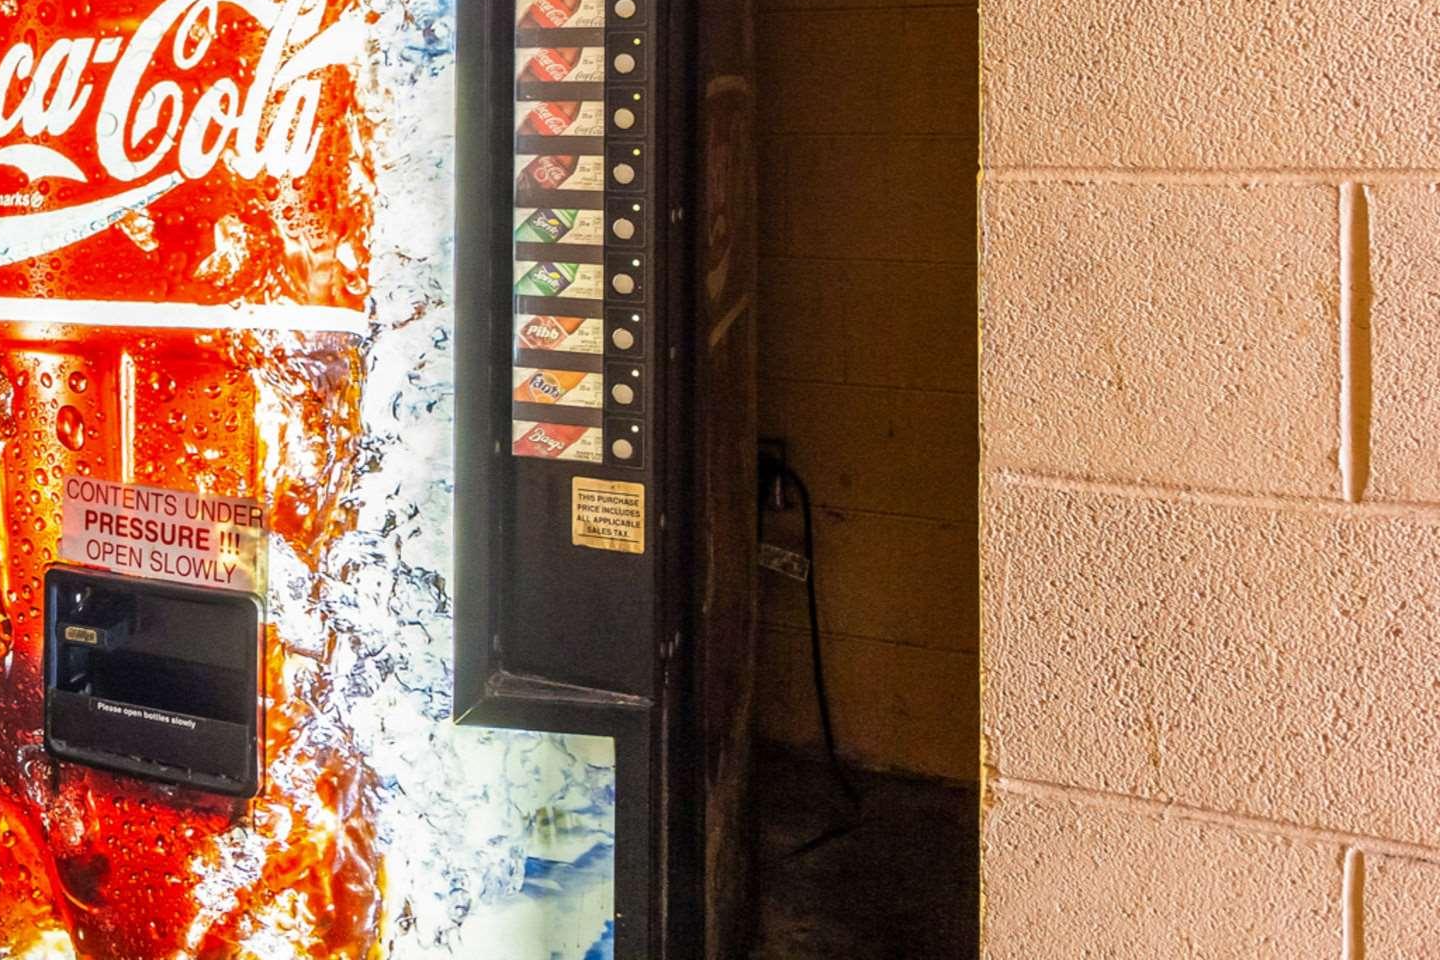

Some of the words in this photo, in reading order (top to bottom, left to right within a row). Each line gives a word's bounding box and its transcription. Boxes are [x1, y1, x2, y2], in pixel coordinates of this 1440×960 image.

[66, 478, 177, 516] CONTENTS
[185, 497, 264, 529] UNDER
[577, 503, 600, 513] PRICE
[601, 506, 641, 518] INCLUDES
[578, 493, 595, 502] THIS
[597, 495, 640, 508] PURCHASE
[577, 514, 592, 523] ALL
[593, 516, 641, 528] APPLICABLE
[587, 526, 612, 536] SALES
[613, 529, 628, 538] TAX
[85, 510, 211, 552] PRESSURE
[219, 531, 241, 555] !!!
[86, 539, 143, 569] OPEN
[150, 550, 237, 584] SLOWLY
[97, 701, 122, 714] Please
[123, 707, 142, 718] open
[143, 710, 170, 723] bottles
[171, 716, 196, 730] slowly
